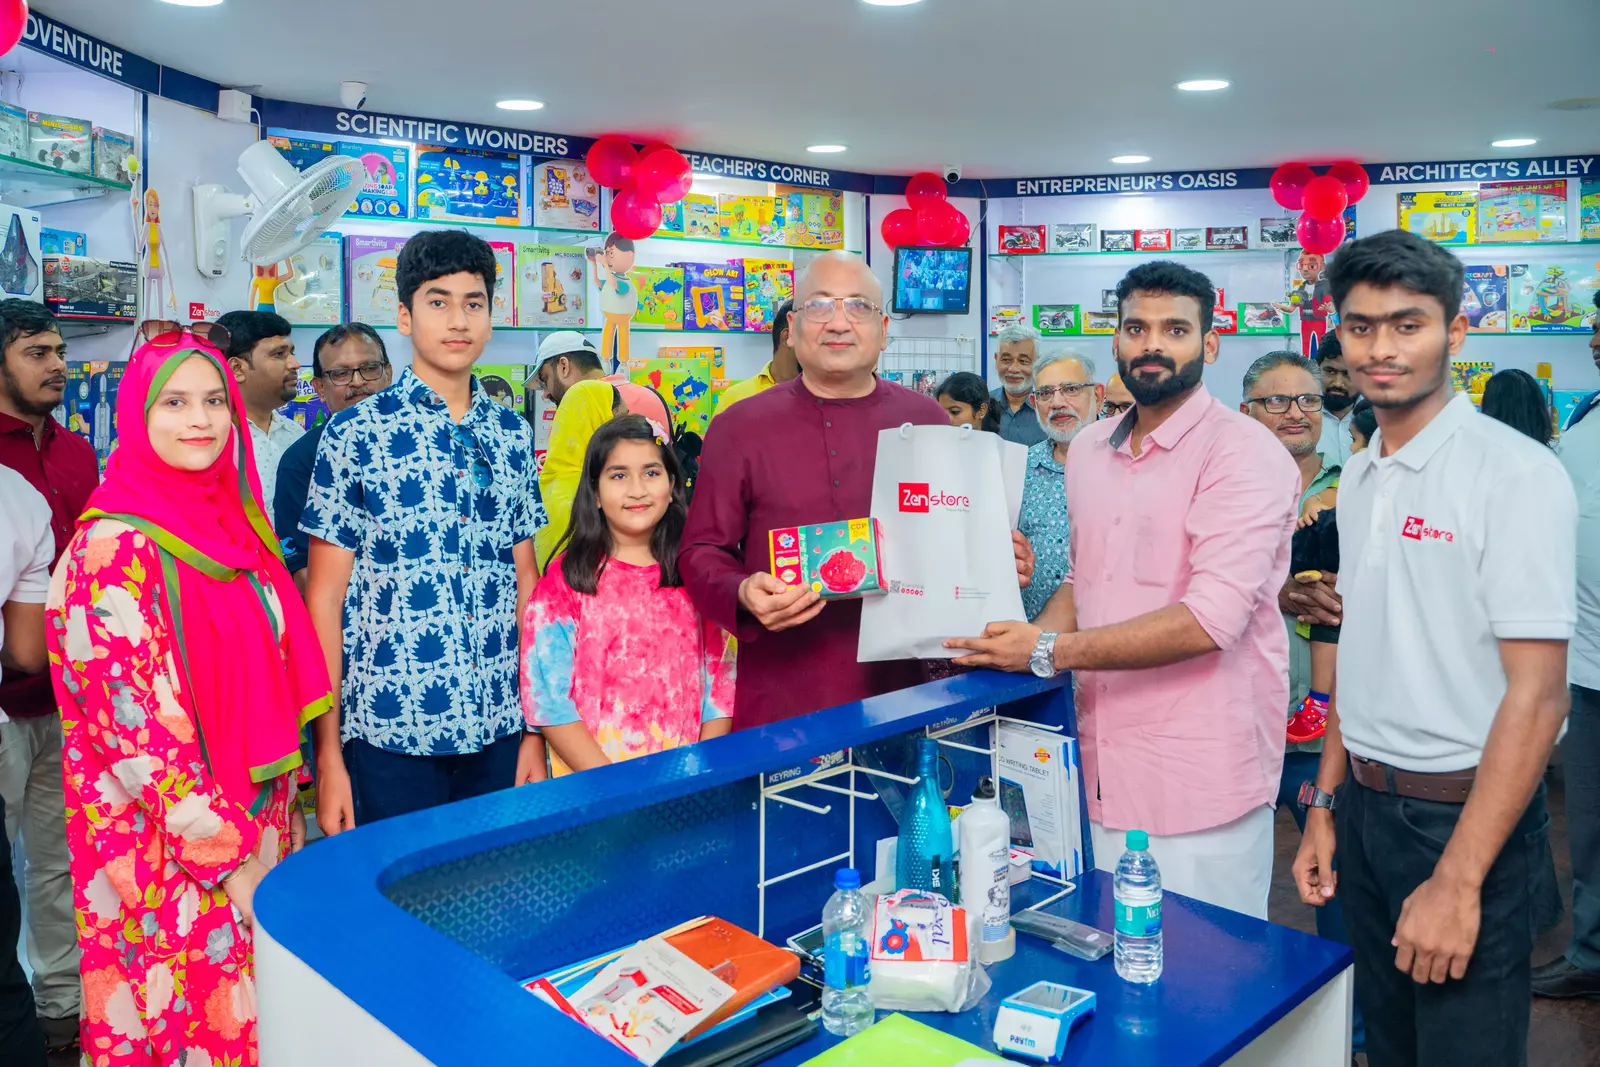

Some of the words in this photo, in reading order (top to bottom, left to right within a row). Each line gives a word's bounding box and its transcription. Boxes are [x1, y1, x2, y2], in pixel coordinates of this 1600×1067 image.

[24, 15, 123, 77] DVENTURE
[336, 112, 459, 144] SCIENTIFIC
[465, 128, 569, 156] WONDERS
[684, 154, 766, 179] TEACHER'S
[770, 165, 830, 186] CORNER
[1380, 161, 1520, 181] ARCHITECT'S
[1526, 158, 1594, 177] ALLEY
[1016, 174, 1173, 195] ENTREPRENEUR'S
[1178, 172, 1237, 189] OASIS
[703, 268, 725, 278] GLOW
[725, 269, 739, 279] ART
[903, 489, 970, 508] Zenstore
[768, 766, 802, 784] KEYRING
[1005, 758, 1028, 771] WRITING
[1029, 765, 1050, 776] TABLET
